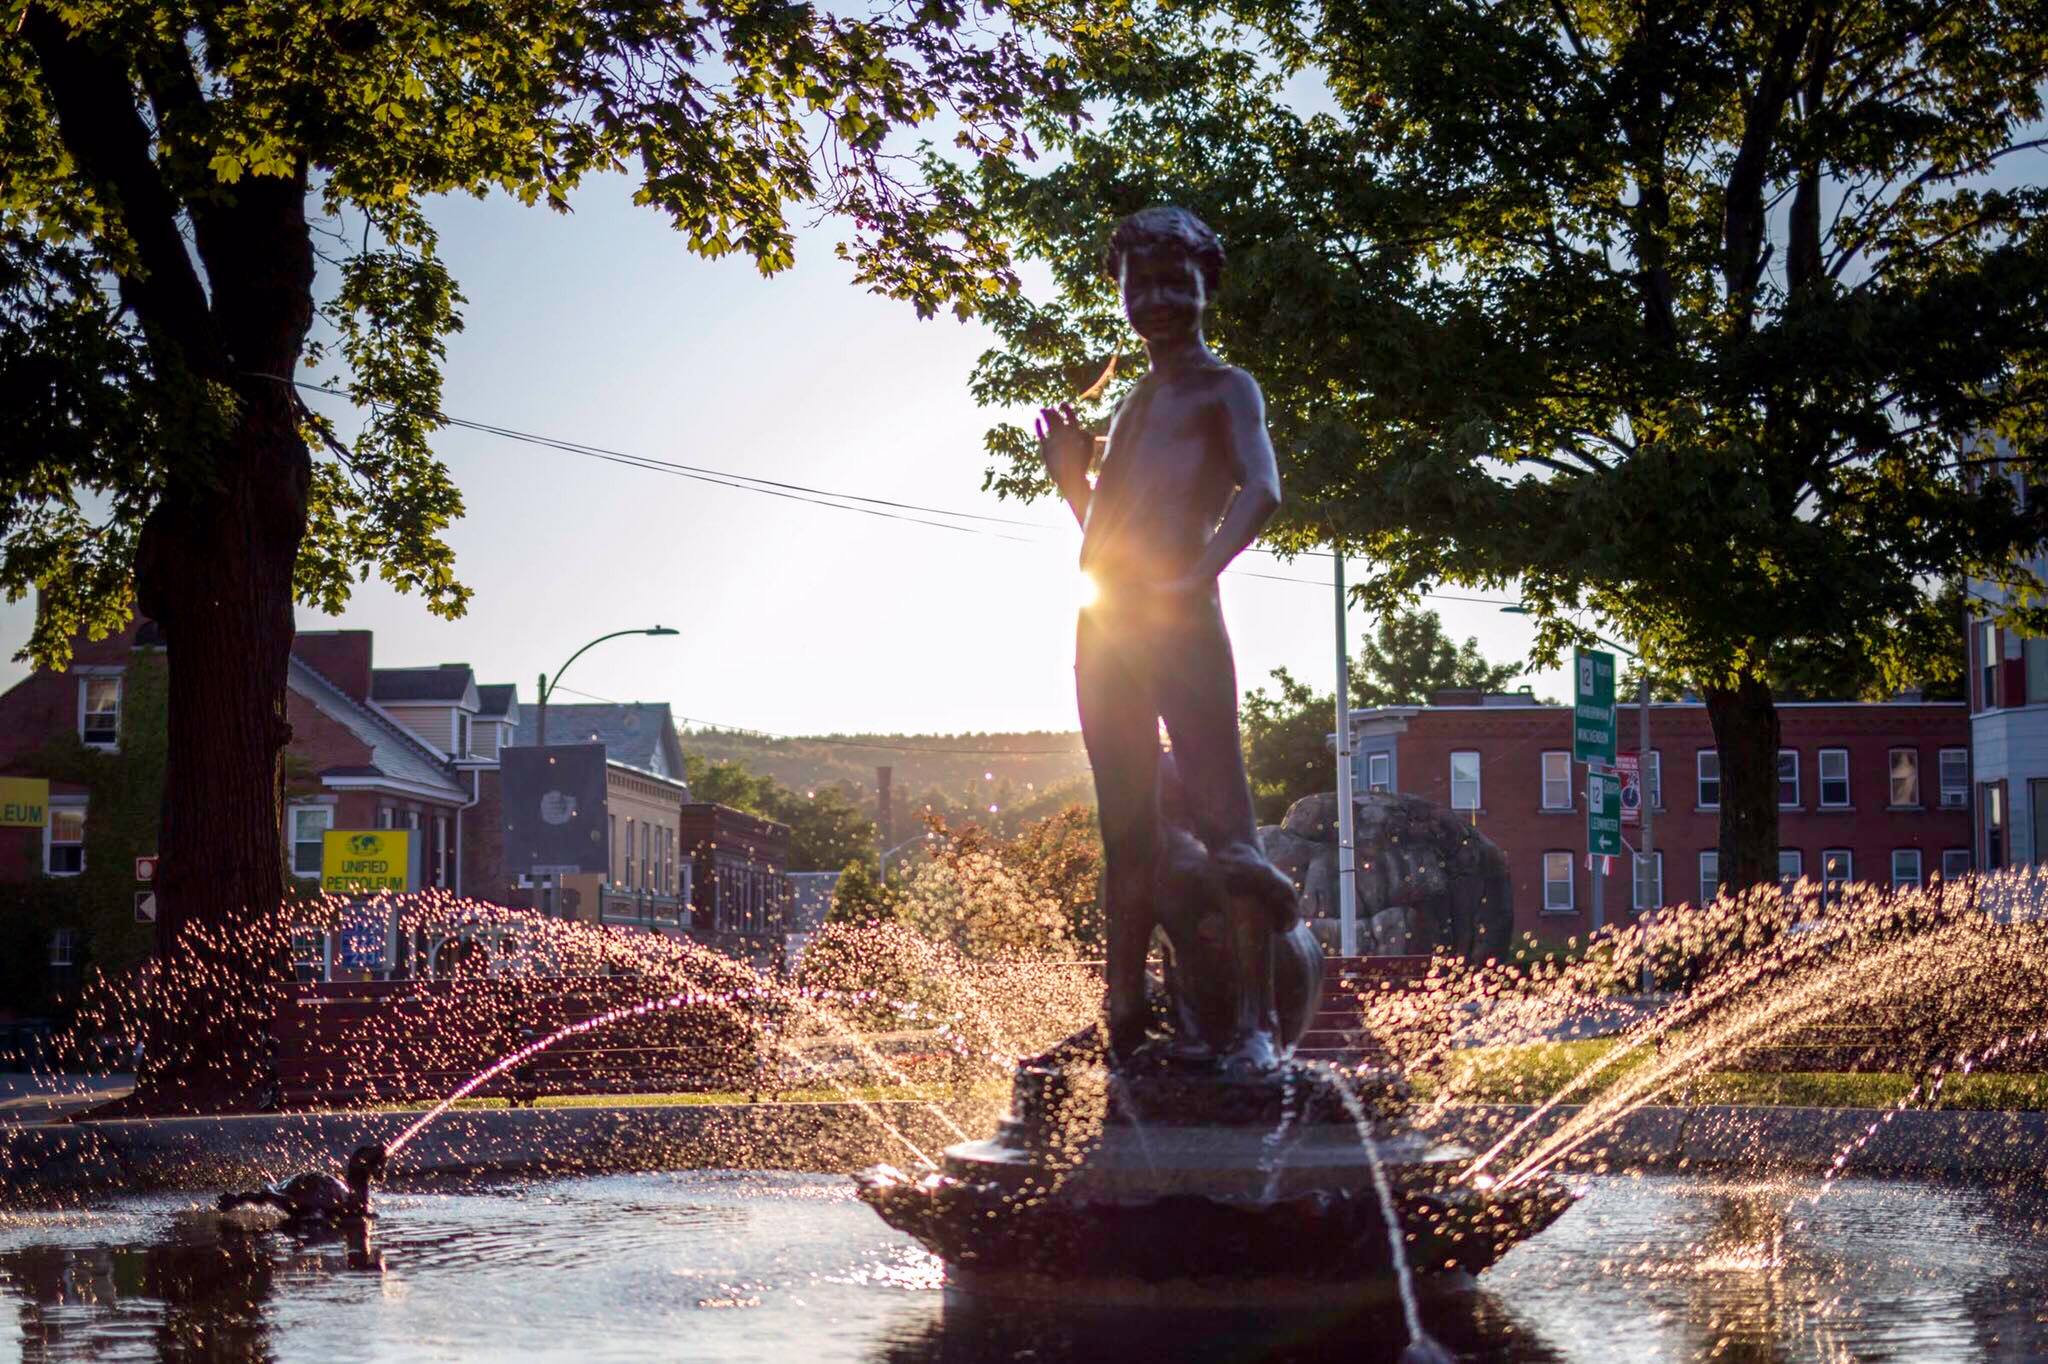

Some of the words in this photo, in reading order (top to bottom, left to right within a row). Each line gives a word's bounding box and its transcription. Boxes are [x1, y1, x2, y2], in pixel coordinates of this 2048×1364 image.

[1582, 667, 1591, 688] 12
[1592, 785, 1600, 804] 12
[341, 860, 389, 874] UNIFIED
[326, 876, 404, 890] PETROLEUM
